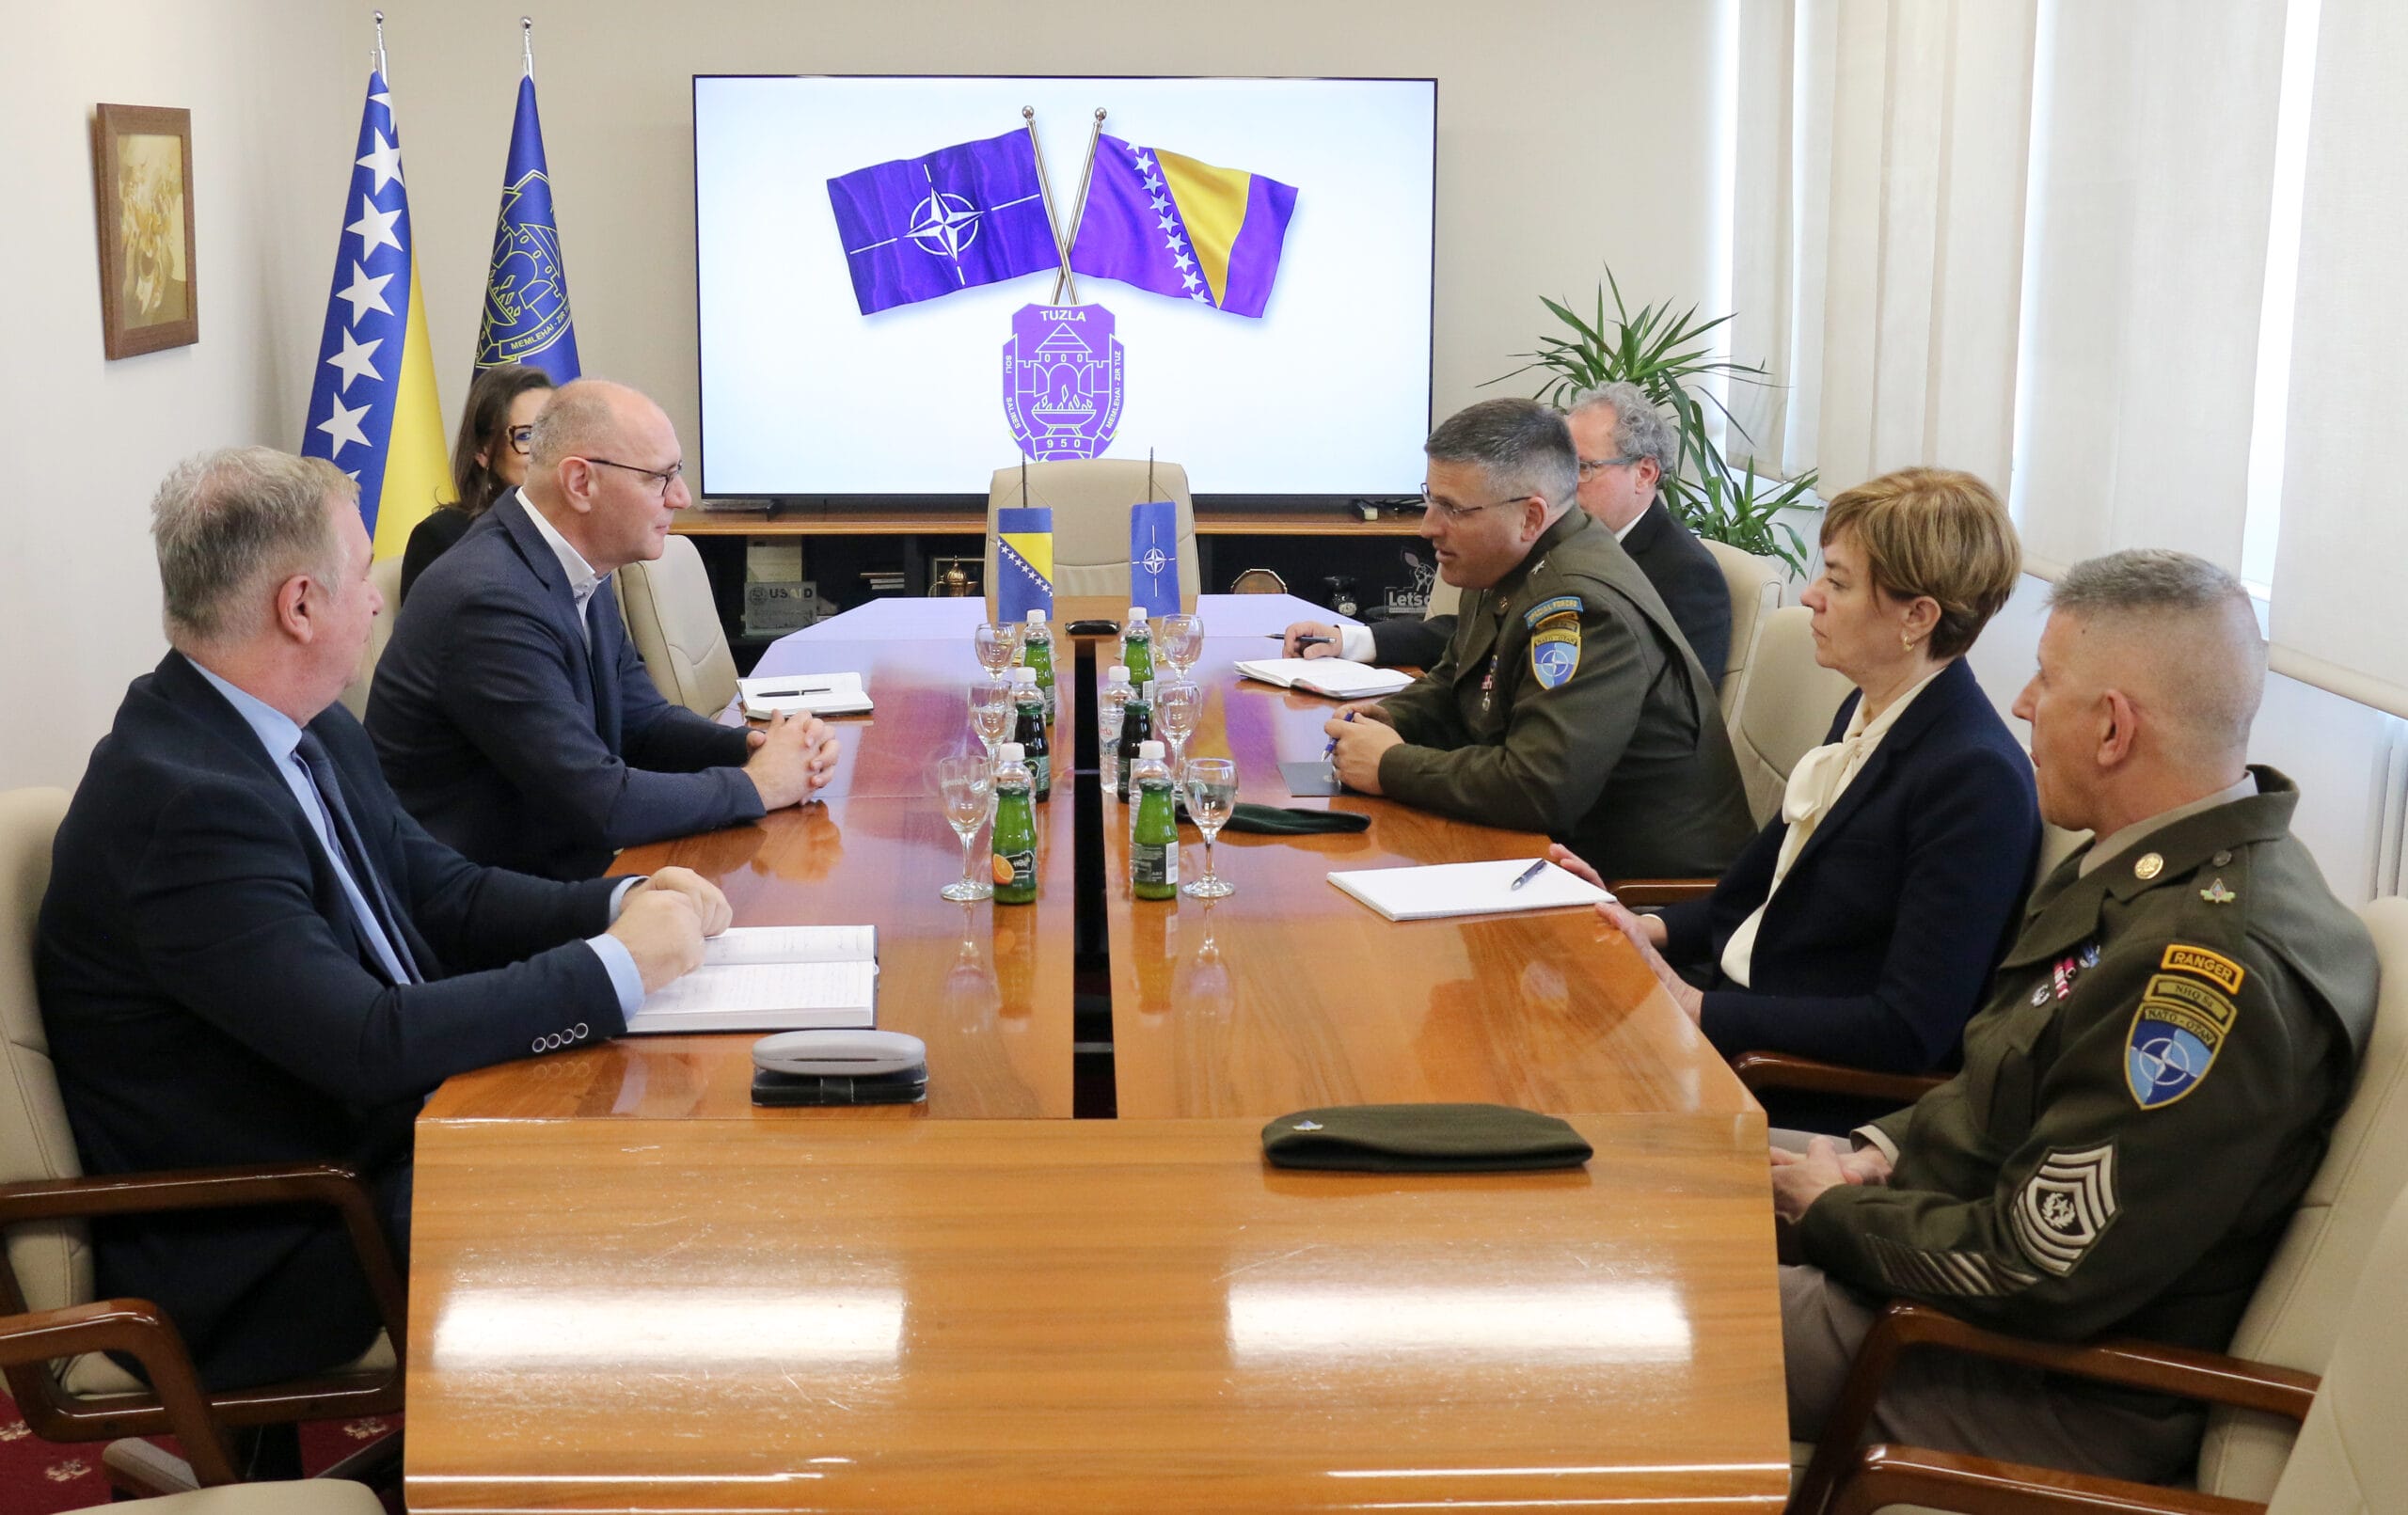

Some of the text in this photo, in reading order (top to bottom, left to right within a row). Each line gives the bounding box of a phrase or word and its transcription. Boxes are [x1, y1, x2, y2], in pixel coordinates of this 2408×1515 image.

[1039, 309, 1086, 323] TUZLA
[511, 323, 555, 350] MEMLEHAI
[1105, 387, 1121, 429] MEMLEHAI
[769, 588, 813, 599] USAID
[2174, 952, 2233, 981] RANGER
[2176, 985, 2201, 999] NHQ
[2148, 1009, 2178, 1022] NATO
[2185, 1021, 2211, 1042] OTAN
